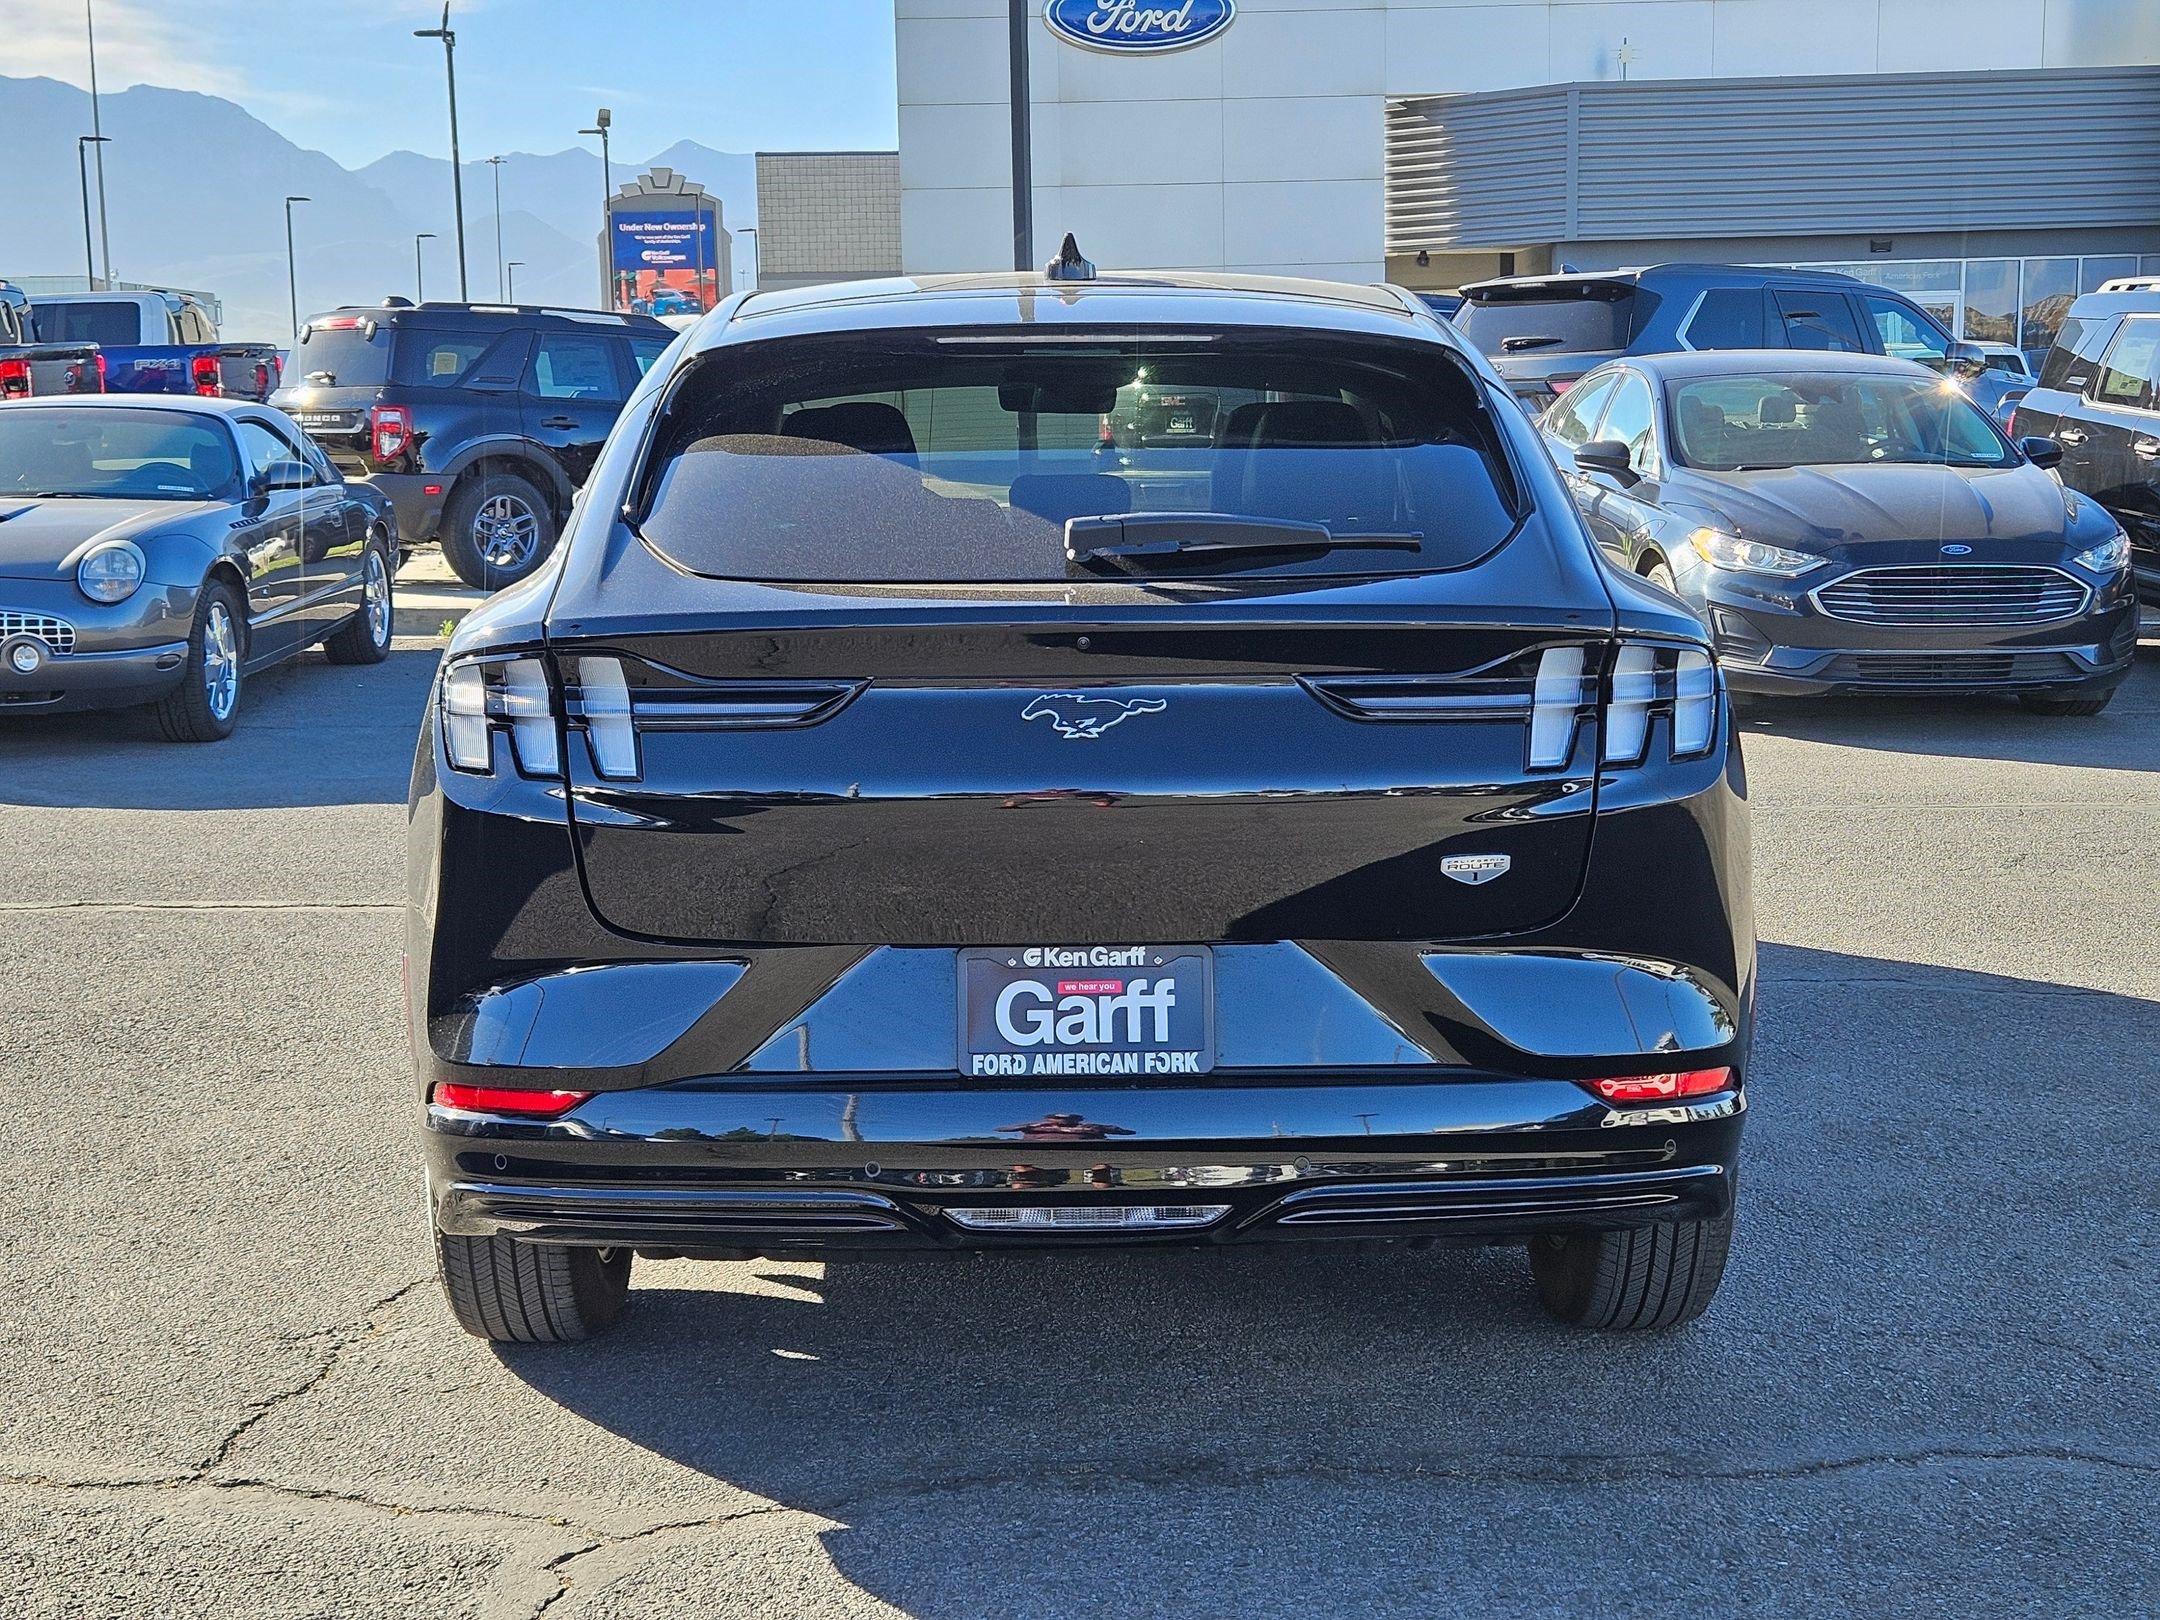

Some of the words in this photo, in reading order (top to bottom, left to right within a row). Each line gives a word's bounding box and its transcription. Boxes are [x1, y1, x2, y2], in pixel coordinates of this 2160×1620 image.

[1086, 0, 1192, 33] Ford
[618, 223, 643, 232] Under
[644, 222, 663, 231] New
[663, 222, 706, 232] Ownershp
[1170, 417, 1193, 429] Garff
[1447, 862, 1505, 870] ROUTE
[1044, 947, 1087, 967] Ken
[1090, 946, 1145, 967] Garff
[1064, 983, 1077, 991] we
[1078, 982, 1098, 991] hear
[1098, 983, 1115, 993] you
[995, 979, 1176, 1047] Garff
[972, 1053, 1027, 1075] FORD
[1032, 1052, 1138, 1075] AMERICAN
[1145, 1051, 1199, 1074] FORK
